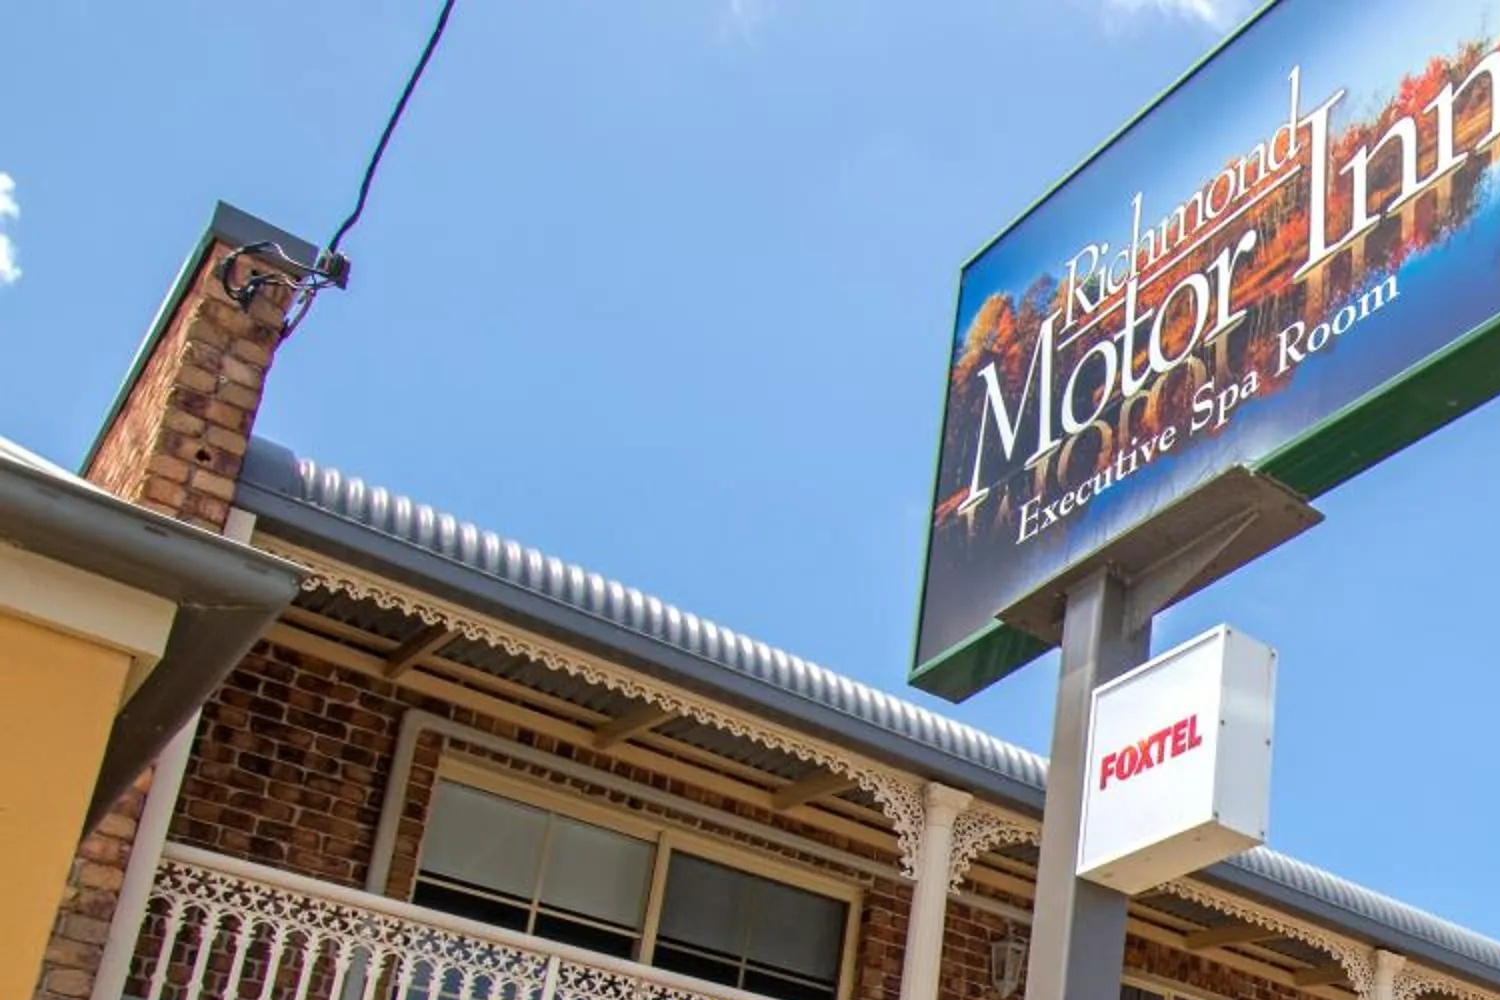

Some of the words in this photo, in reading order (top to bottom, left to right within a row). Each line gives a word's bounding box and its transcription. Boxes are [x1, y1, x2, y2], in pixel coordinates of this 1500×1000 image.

[1060, 65, 1302, 333] Richmond
[958, 230, 1257, 514] Motor
[1016, 425, 1177, 544] Executive
[1190, 369, 1260, 436] Spa
[1273, 275, 1400, 377] Room
[1100, 714, 1202, 790] FOXTEL
